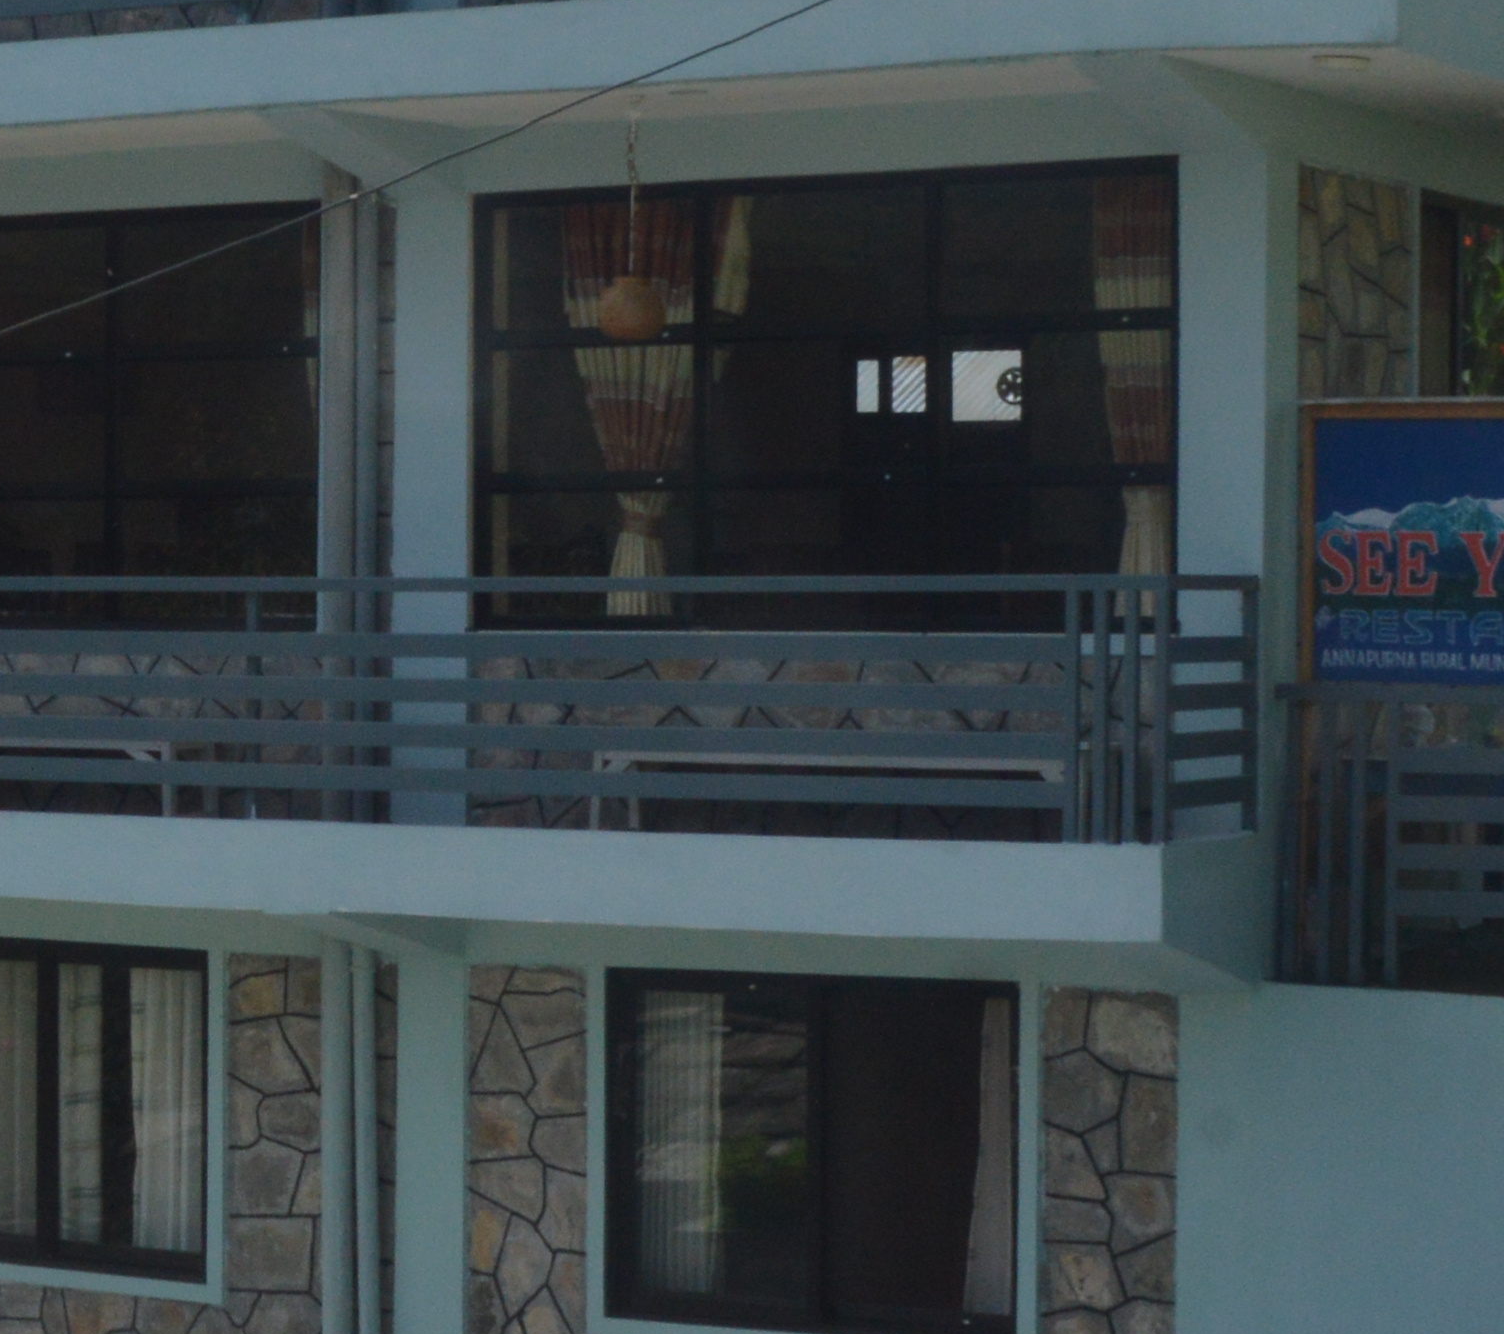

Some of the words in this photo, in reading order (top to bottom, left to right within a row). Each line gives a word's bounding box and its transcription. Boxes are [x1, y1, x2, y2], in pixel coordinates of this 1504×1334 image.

[1317, 530, 1438, 598] SEE
[1321, 647, 1420, 669] ANNAPURNA
[1420, 650, 1466, 671] RURAL
